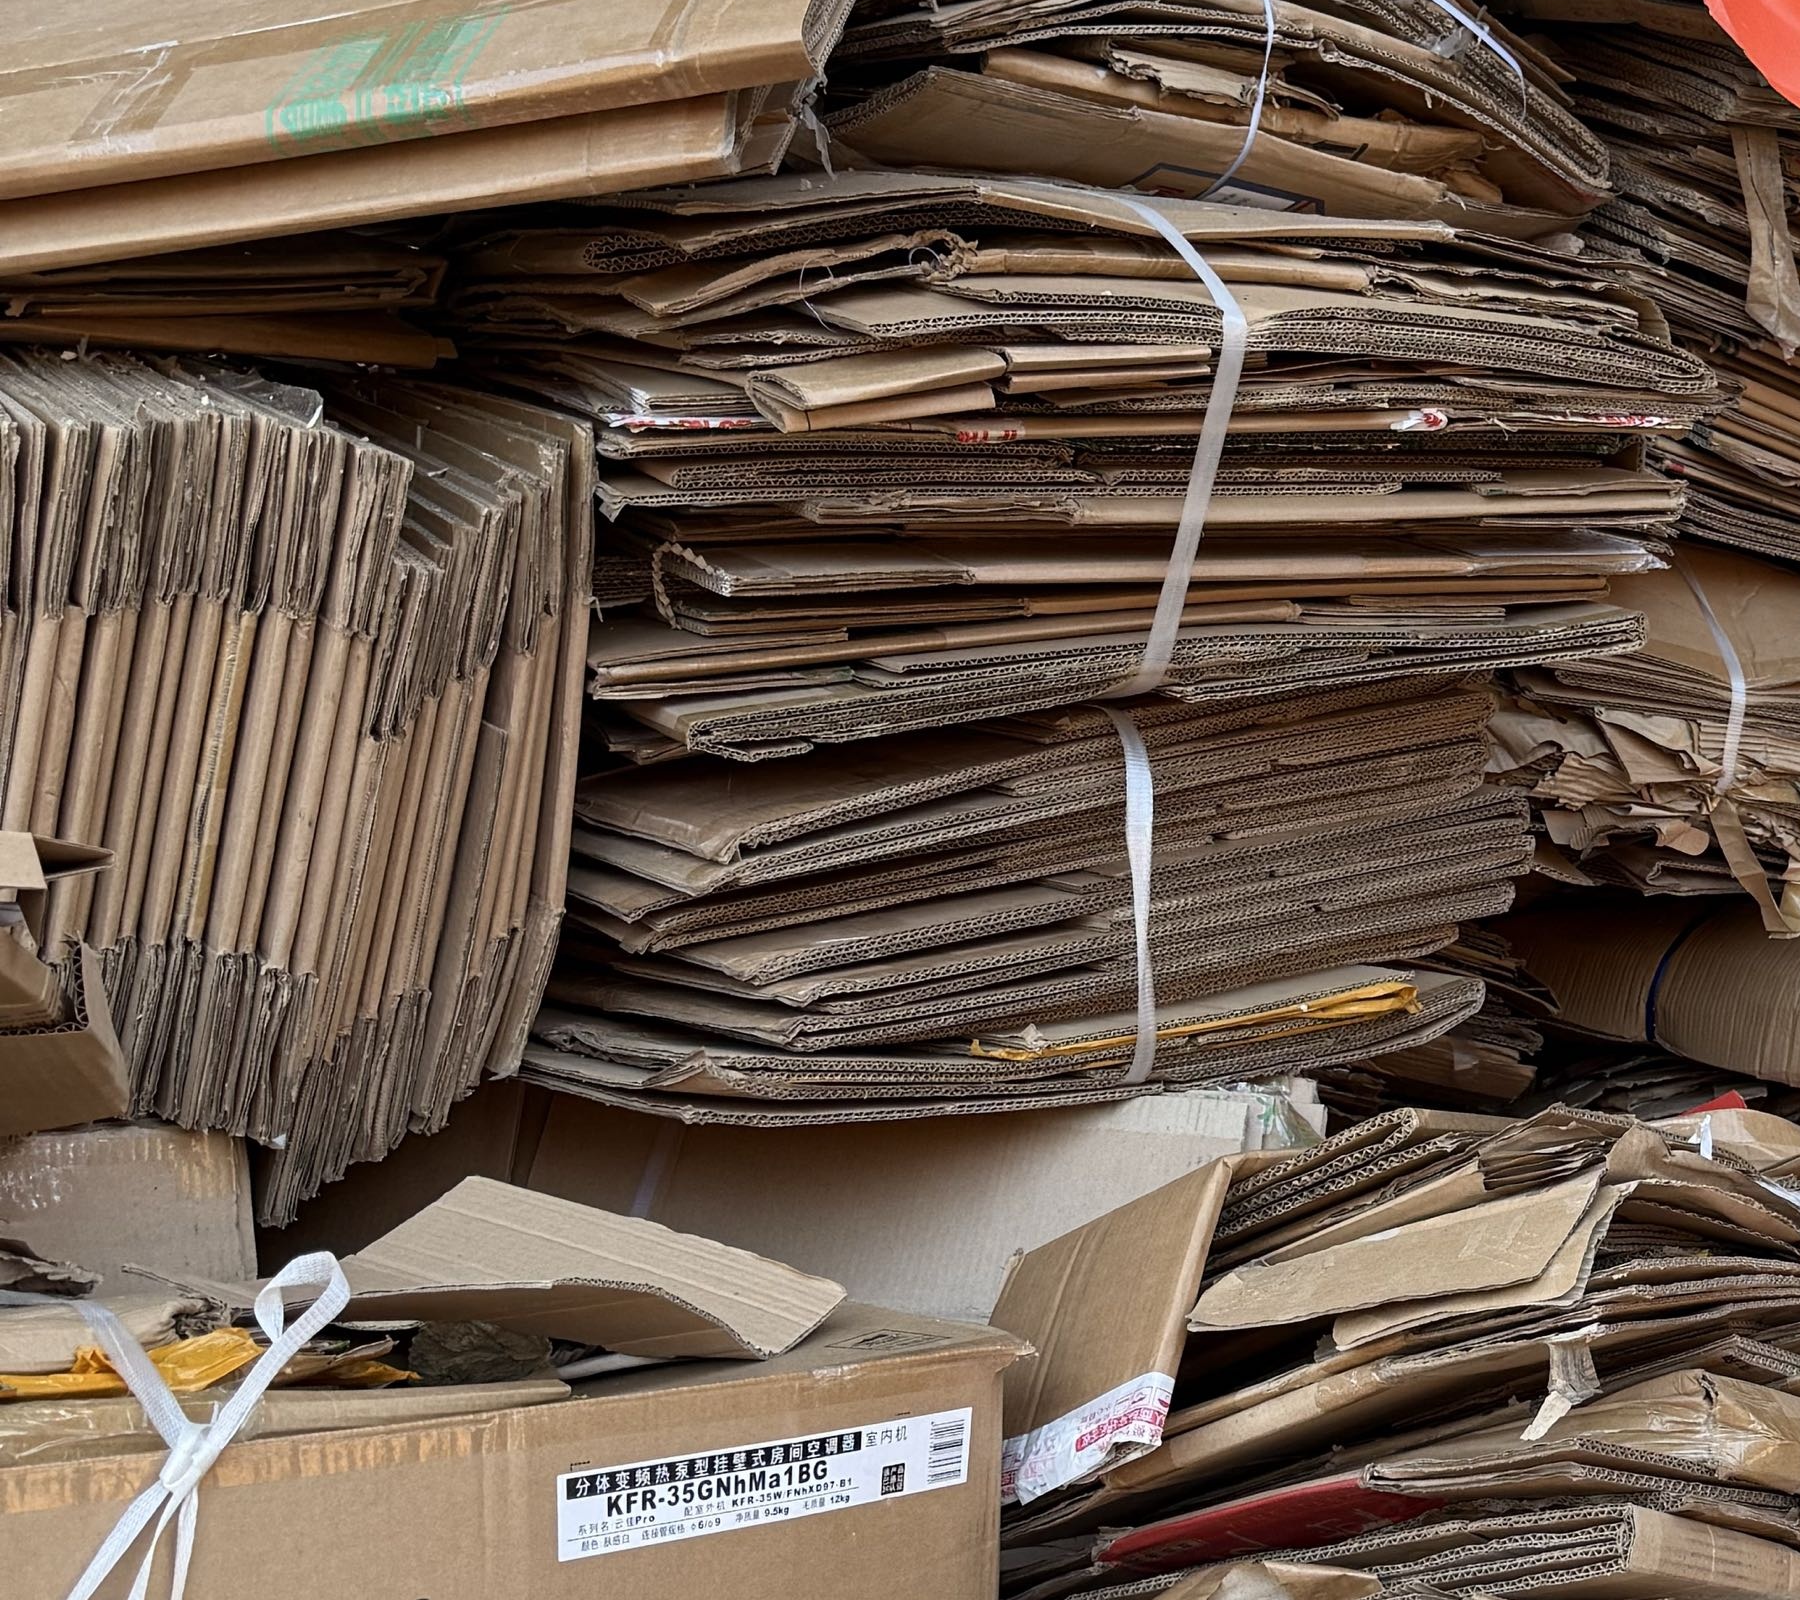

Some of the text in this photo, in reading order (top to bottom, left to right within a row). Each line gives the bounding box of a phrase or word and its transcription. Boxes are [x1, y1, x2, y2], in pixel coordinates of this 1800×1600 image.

[567, 1431, 862, 1500] 分体变频热泵型挂壁式房间空调器
[865, 1425, 908, 1448] 室内机
[606, 1459, 829, 1518] KFR-35GNhMa1BG
